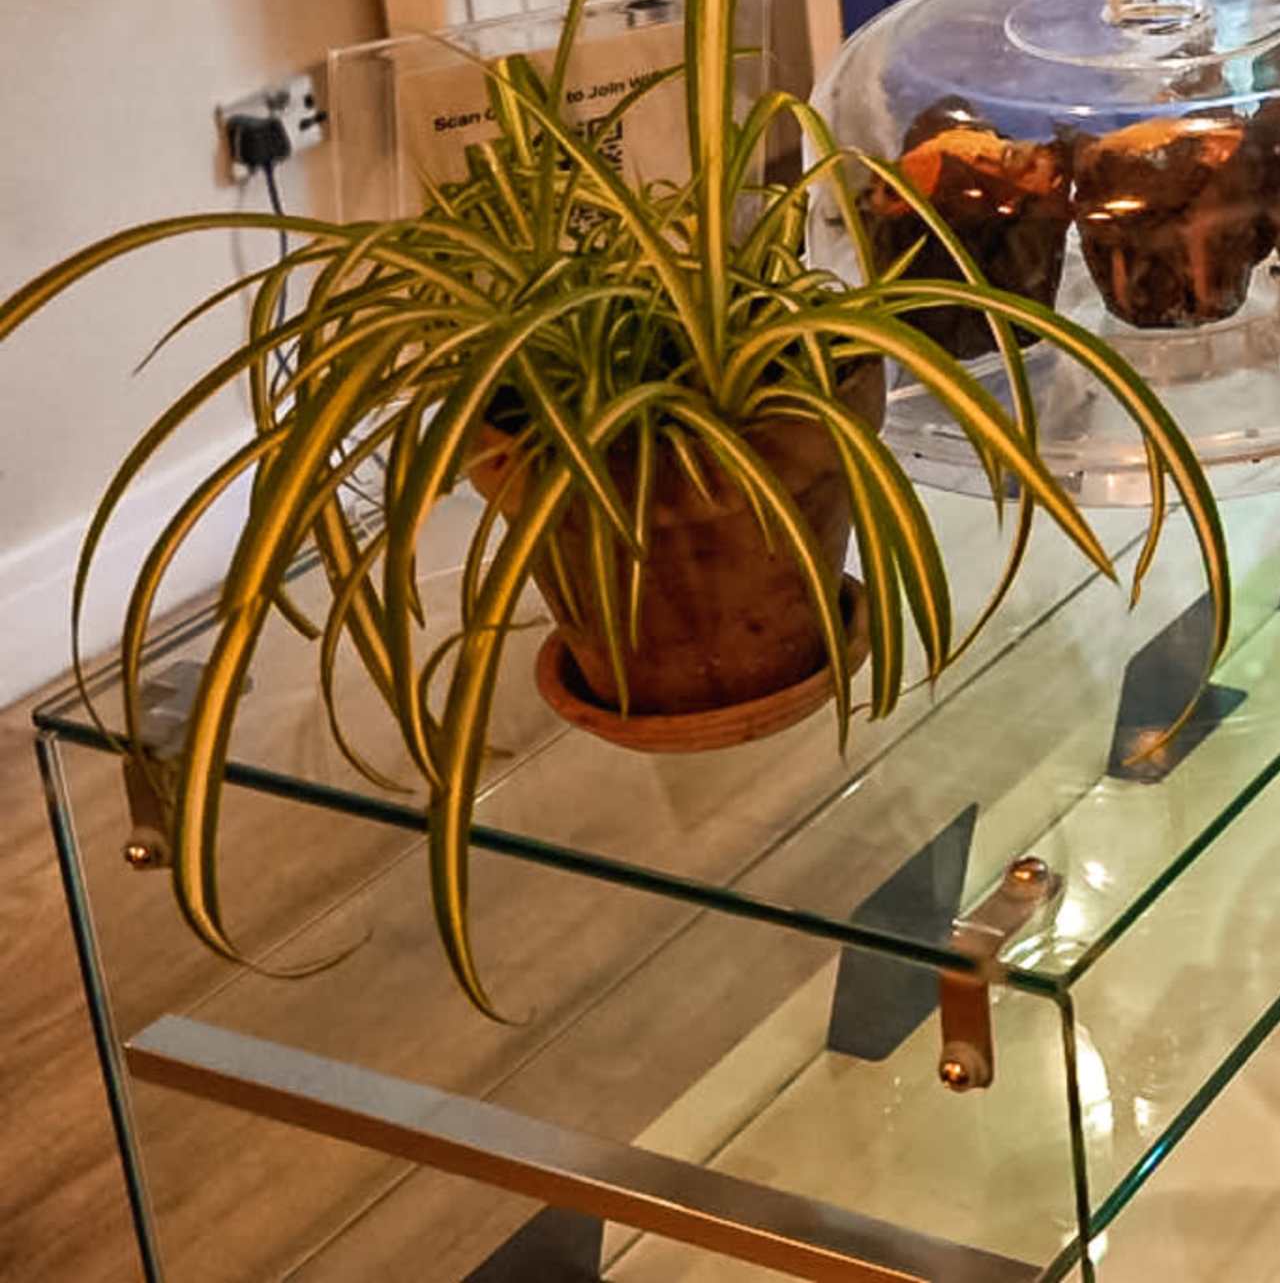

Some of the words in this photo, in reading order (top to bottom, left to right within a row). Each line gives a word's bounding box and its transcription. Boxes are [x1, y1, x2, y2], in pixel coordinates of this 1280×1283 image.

[433, 108, 482, 132] Scan
[566, 86, 585, 103] to
[589, 80, 626, 100] Join
